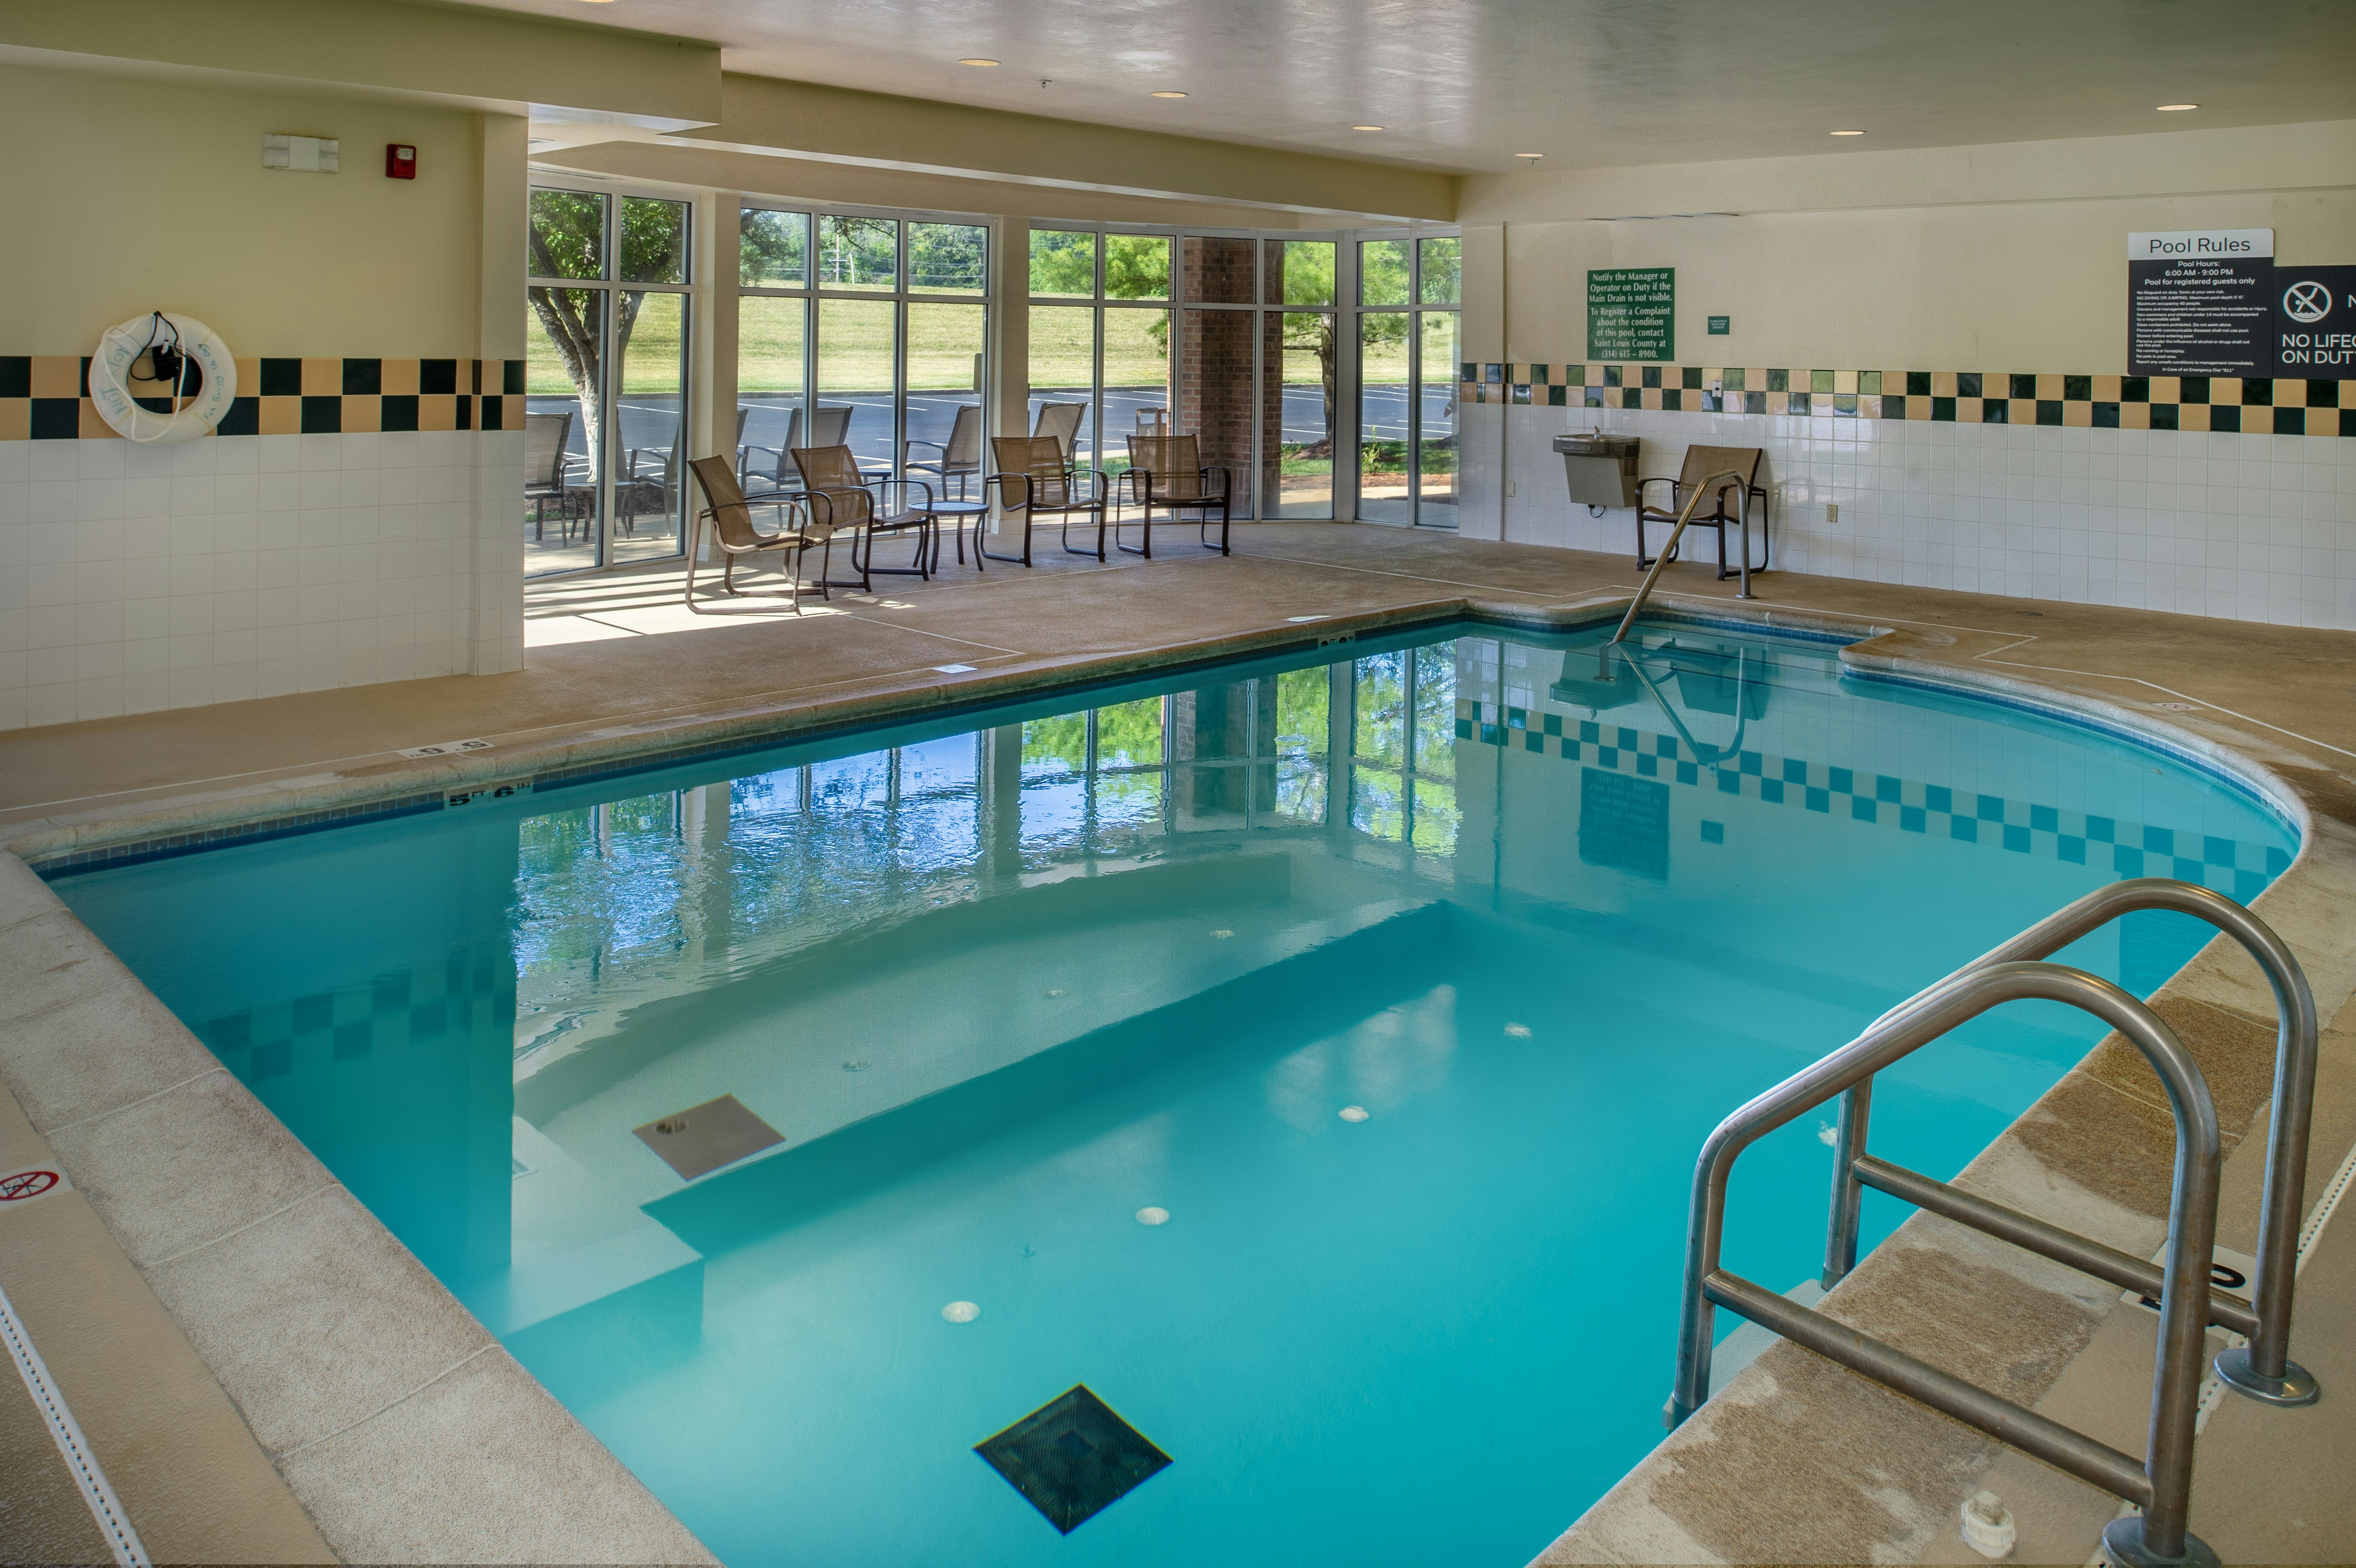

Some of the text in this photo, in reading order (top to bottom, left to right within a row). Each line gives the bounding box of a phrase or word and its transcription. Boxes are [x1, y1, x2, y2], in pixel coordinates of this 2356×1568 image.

[2150, 237, 2251, 253] Pool Rules
[1593, 273, 1613, 282] Notify
[1615, 272, 1626, 281] the
[1628, 272, 1658, 282] Manager
[1590, 283, 1620, 293] Operator
[1634, 282, 1650, 292] Duty
[1653, 282, 1657, 290] if
[1659, 281, 1670, 290] the
[1607, 293, 1625, 302] Drain
[1628, 293, 1633, 302] is
[1649, 292, 1672, 301] visible.
[1601, 307, 1626, 317] Register
[1635, 306, 1670, 316] Complaint
[1597, 317, 1663, 326] about the condition
[1597, 328, 1603, 337] of
[1605, 328, 1616, 337] this
[1619, 328, 1635, 338] pool,
[1594, 339, 1611, 347] Saint
[1613, 339, 1630, 347] Louis
[1632, 339, 1657, 349] County
[2282, 335, 2310, 348] NO
[103, 346, 129, 368] TOY
[1601, 350, 1617, 358] (314)
[1619, 350, 1630, 358] 615
[1638, 350, 1657, 358] 8900.
[2282, 350, 2356, 364] ON DUT
[100, 388, 128, 415] NOT
[449, 793, 470, 806] 5
[494, 786, 514, 797] 6
